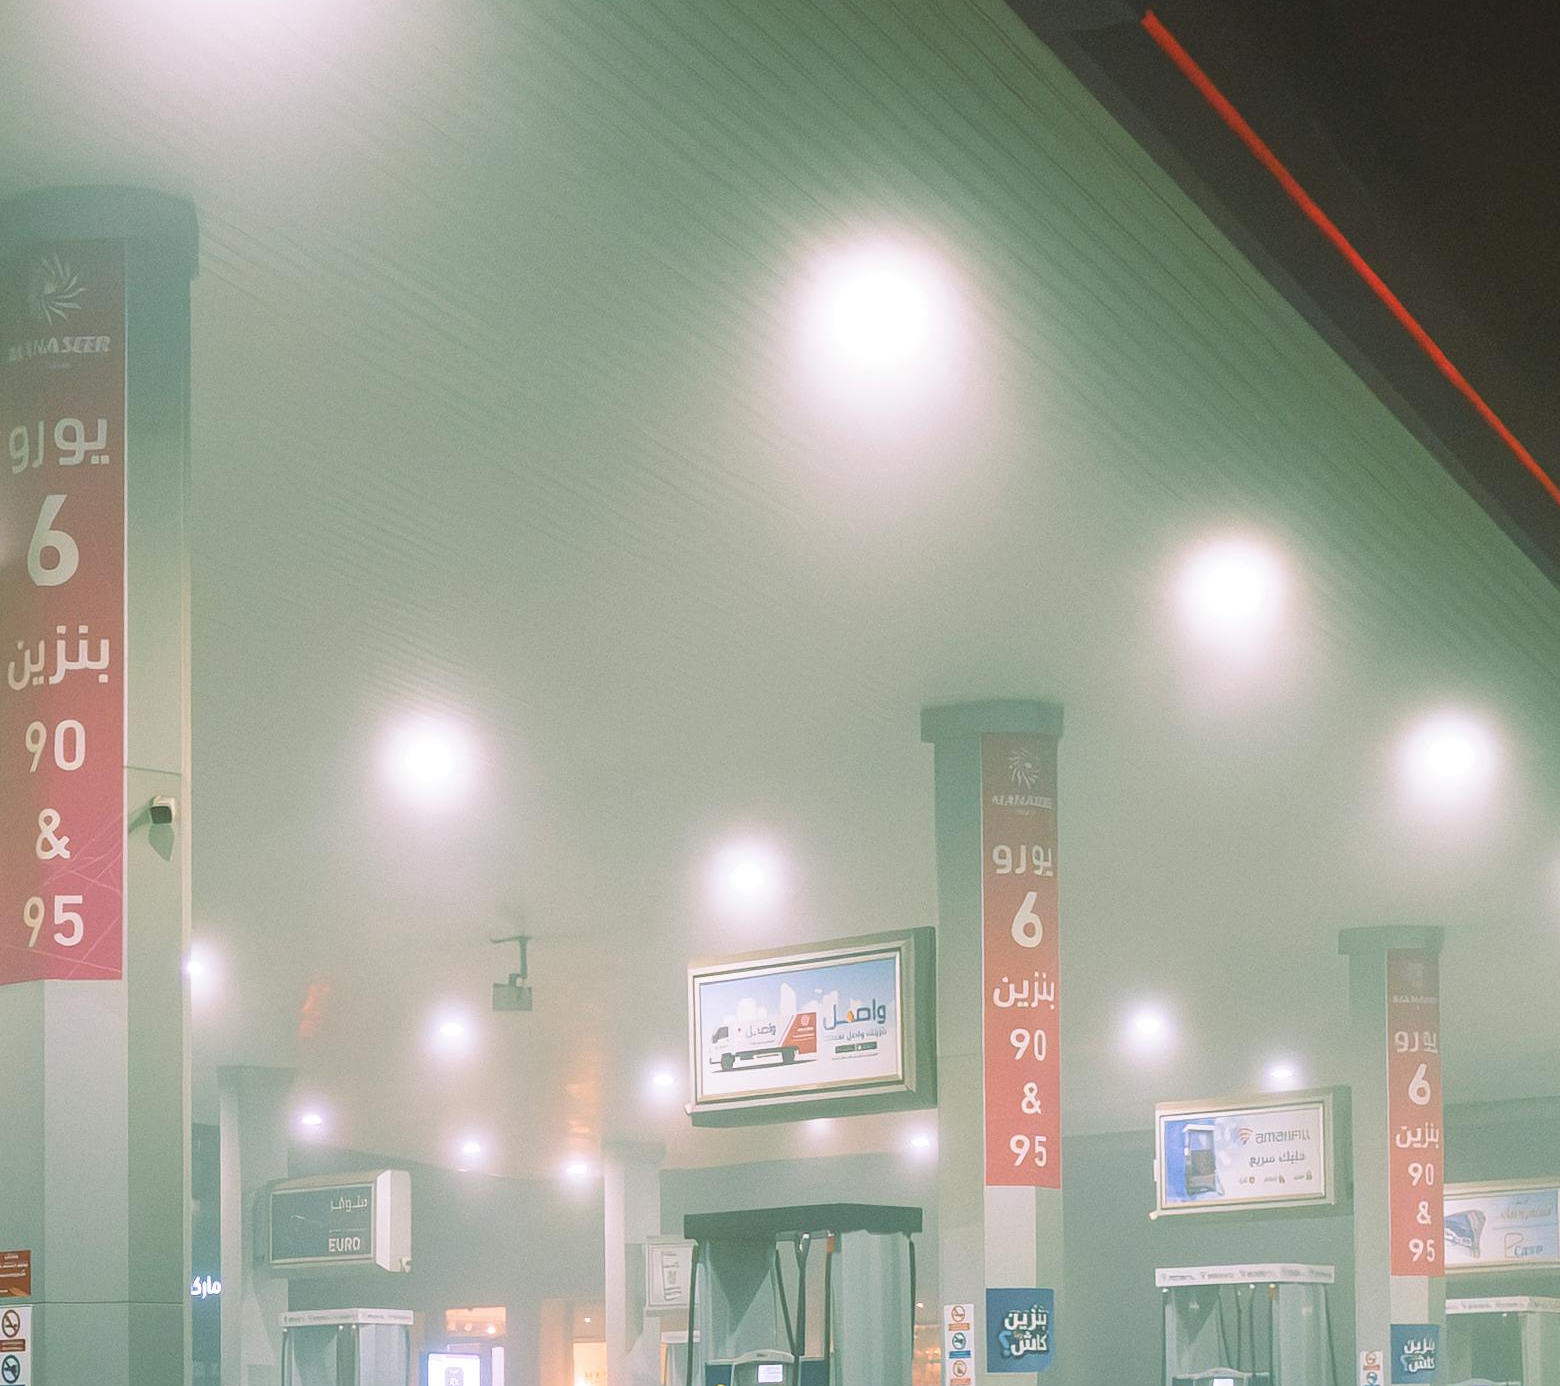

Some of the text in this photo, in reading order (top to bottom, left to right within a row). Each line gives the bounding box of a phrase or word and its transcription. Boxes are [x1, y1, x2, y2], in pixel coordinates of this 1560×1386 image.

[8, 416, 110, 473] يورو
[27, 495, 80, 587] 6
[7, 625, 110, 691] بنزين
[25, 720, 86, 772] 90
[36, 808, 71, 860] &
[992, 844, 1054, 876] يورو
[22, 896, 84, 947] 95
[1012, 891, 1043, 948] 6
[993, 971, 1055, 1010] بنزين
[1010, 1029, 1047, 1061] 90
[1021, 1082, 1042, 1114] &
[1408, 1063, 1431, 1106] 6
[1010, 1135, 1047, 1168] 95
[1408, 1163, 1434, 1186] 90
[1416, 1201, 1431, 1224] &
[328, 1236, 360, 1252] EURO
[1408, 1238, 1436, 1262] 95
[191, 1275, 221, 1299] مارك
[1004, 1305, 1047, 1330] بنزين
